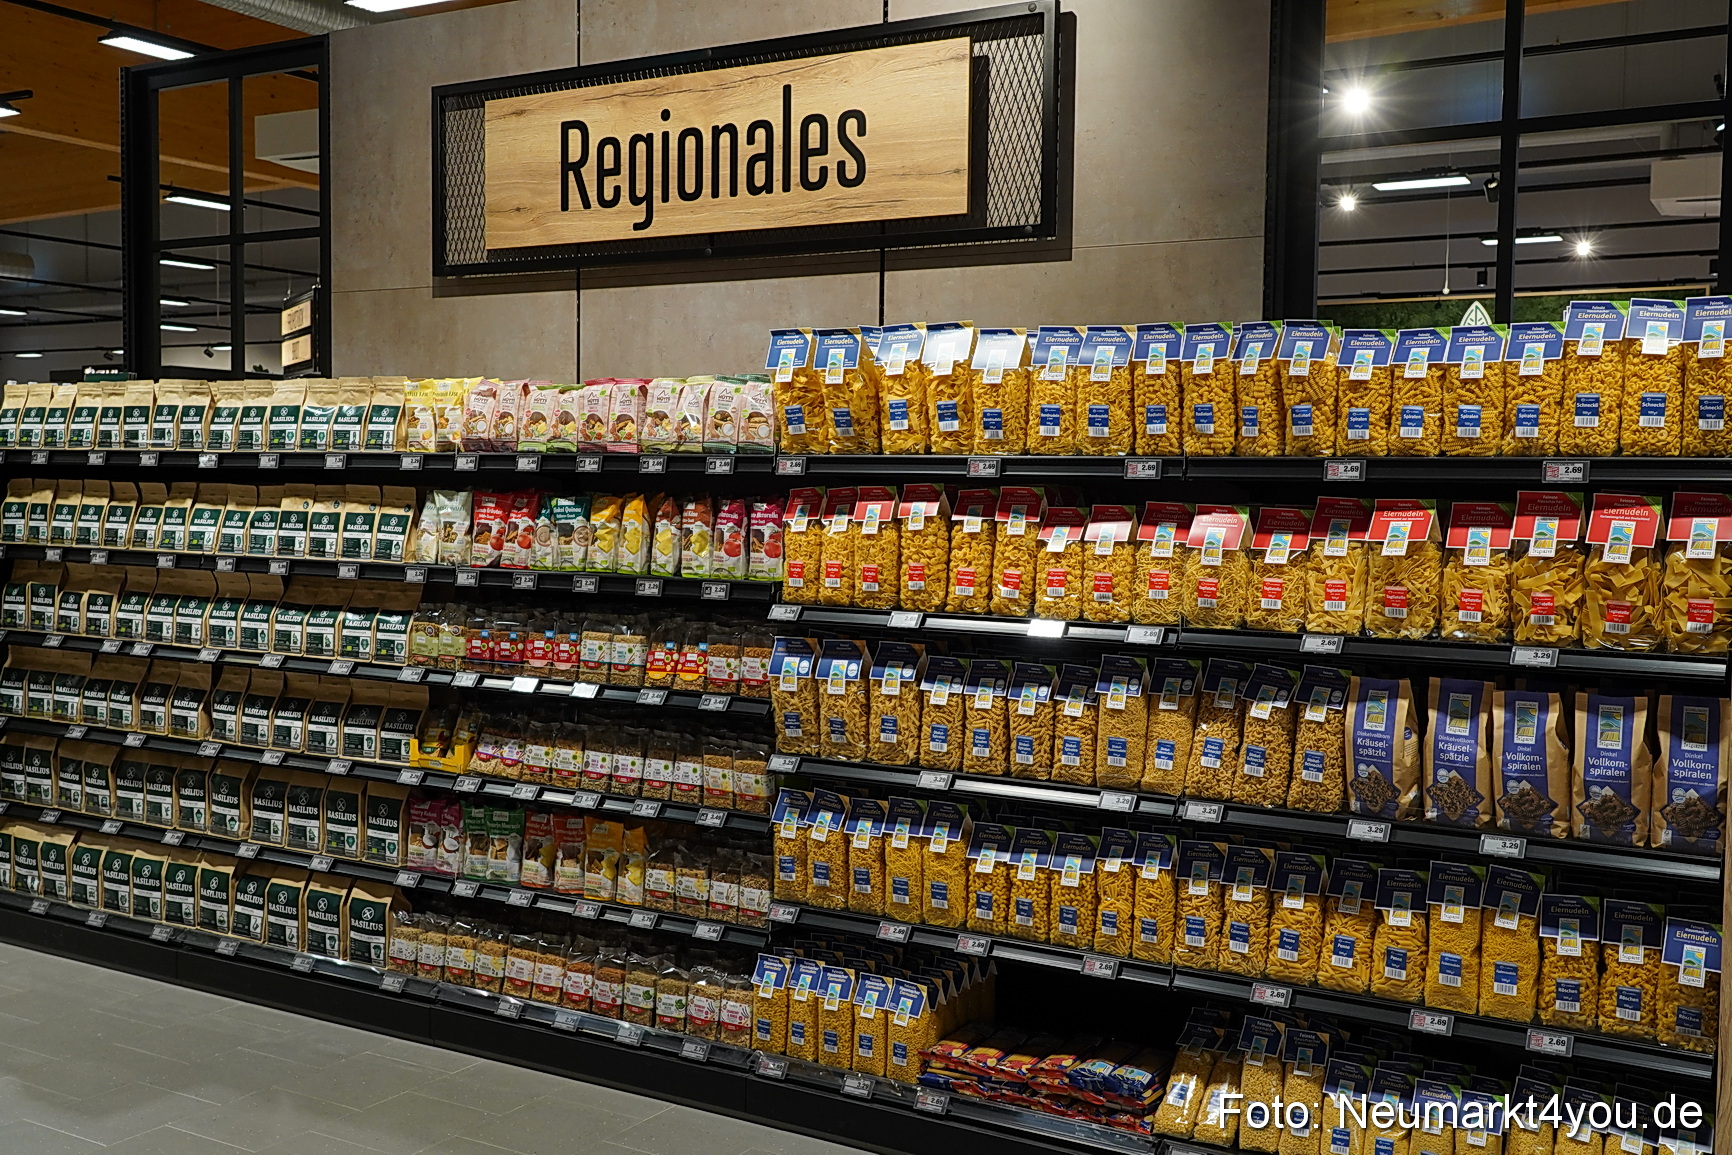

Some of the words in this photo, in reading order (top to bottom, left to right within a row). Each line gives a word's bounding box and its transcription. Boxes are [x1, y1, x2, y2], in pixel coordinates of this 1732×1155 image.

[560, 83, 868, 232] Regionales
[1578, 312, 1616, 320] Eiernudeln
[1639, 311, 1680, 319] Eiernudeln
[1695, 308, 1732, 317] Eiernudel
[888, 334, 918, 342] Eiernudeln
[1045, 336, 1080, 344] Eiernudeln
[1518, 333, 1556, 341] Eiernudeln
[1405, 338, 1440, 346] Eiernudeln
[1564, 466, 1582, 474] 2.69
[1527, 504, 1571, 512] Eiernudeln
[1603, 508, 1649, 516] Eiernudeln
[1383, 510, 1424, 518] Eiernudeln
[1203, 516, 1237, 524] Eiernudeln
[121, 603, 142, 611] BASILIUS
[151, 606, 173, 614] BASILIUS
[179, 606, 202, 615] BASILIUS
[278, 614, 301, 622] BASILIUS
[345, 619, 370, 627] BASILIUS
[379, 622, 405, 630] BASILIUS
[1533, 652, 1551, 660] 3.29
[56, 686, 78, 694] BASILIUS
[174, 700, 198, 708] BASILIUS
[214, 703, 235, 711] BASILIUS
[245, 707, 267, 716] BASILIUS
[278, 710, 301, 718] BASILIUS
[311, 715, 336, 723] BASILIUS
[348, 718, 375, 726] BASILIUS
[385, 722, 413, 730] BASILIUS
[1357, 731, 1390, 739] Dinkelvollkorn
[1438, 735, 1474, 744] Dinkelvollkorn
[1357, 738, 1388, 748] Kräusel-
[1438, 742, 1472, 752] Kräusel-
[1359, 748, 1386, 758] spätzle
[1440, 752, 1469, 762] spätzle
[1506, 752, 1543, 762] Vollkorn-
[1507, 762, 1541, 772] spiralen
[1588, 757, 1628, 768] Vollkorn-
[1672, 758, 1714, 770] Vollkorn-
[1590, 768, 1625, 778] spiralen
[1674, 769, 1712, 780] spiralen
[117, 778, 142, 788] BASILIUS
[147, 783, 171, 792] BASILIUS
[213, 793, 238, 804] BASILIUS
[254, 798, 282, 808] BASILIUS
[289, 804, 318, 815] BASILIUS
[327, 810, 356, 821] BASILIUS
[369, 816, 397, 827] BASILIUS
[1367, 826, 1383, 834] 3.29
[1501, 842, 1518, 850] 3.29
[1188, 850, 1218, 859] Eiernudeln
[1233, 856, 1264, 864] Eiernudeln
[73, 864, 96, 875] BASILIUS
[1284, 863, 1315, 872] Eiernudeln
[1438, 873, 1475, 883] Eiernudeln
[166, 882, 192, 892] BASILIUS
[1386, 880, 1422, 889] Eiernudeln
[1497, 877, 1533, 891] Eiernudeln
[201, 888, 226, 899] BASILIUS
[237, 892, 263, 904] BASILIUS
[269, 903, 296, 915] BASILIUS
[1550, 906, 1589, 915] Eiernudeln
[309, 909, 337, 922] BASILIUS
[1614, 911, 1653, 922] Eiernudeln
[351, 918, 383, 931] BASILIUS
[1676, 933, 1717, 944] Eiernudeln
[1619, 994, 1638, 1003] Röschen
[1430, 1018, 1446, 1026] 2.69
[1678, 1013, 1700, 1023] Röschen
[1251, 1024, 1276, 1033] Hausmacher
[1548, 1038, 1566, 1046] 2.69
[1335, 1070, 1363, 1079] Eiernudeln
[1380, 1080, 1409, 1089] Eiernudeln
[1422, 1090, 1452, 1100] Eiernudeln
